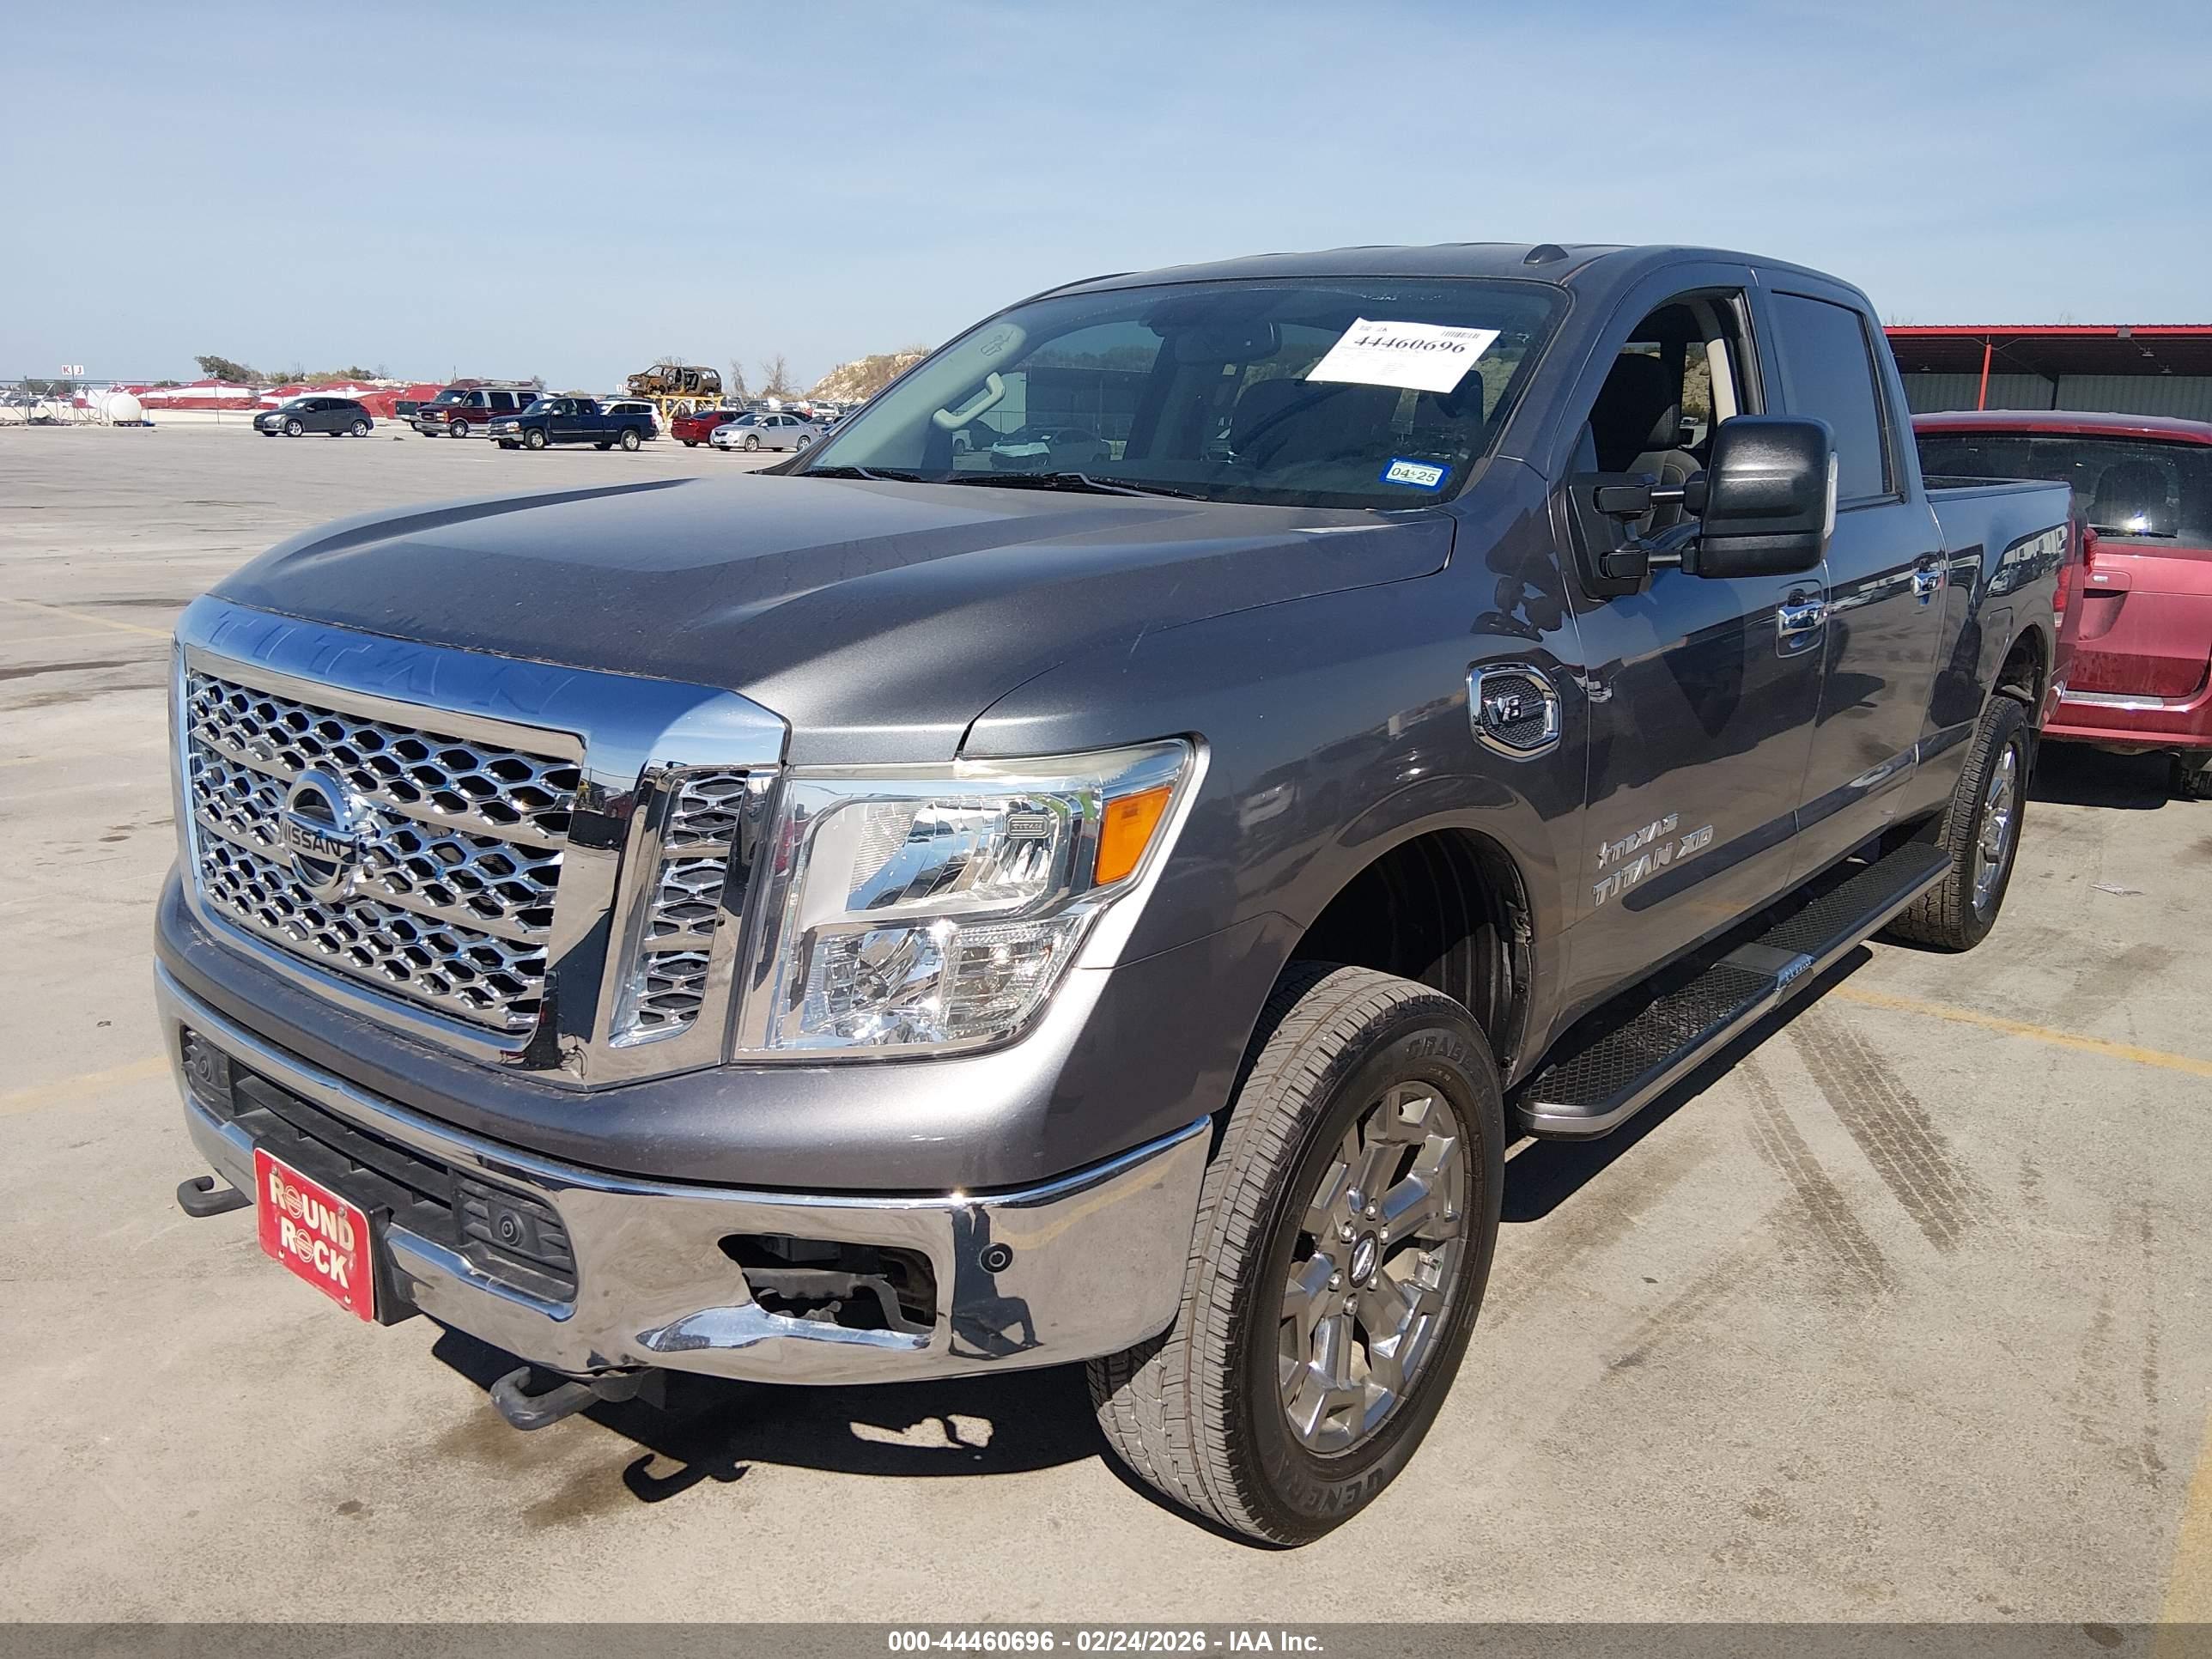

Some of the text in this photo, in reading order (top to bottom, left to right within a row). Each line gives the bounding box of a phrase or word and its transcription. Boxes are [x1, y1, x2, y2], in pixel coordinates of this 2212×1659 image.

[1353, 335, 1467, 354] 44460696
[1391, 467, 1410, 478] 04
[1417, 471, 1437, 483] 25
[207, 610, 577, 715] TITAN
[280, 819, 342, 857] NISSAN
[1593, 824, 1714, 908] TITAN XD
[269, 1172, 356, 1252] ROUND
[280, 1216, 349, 1290] ROCK
